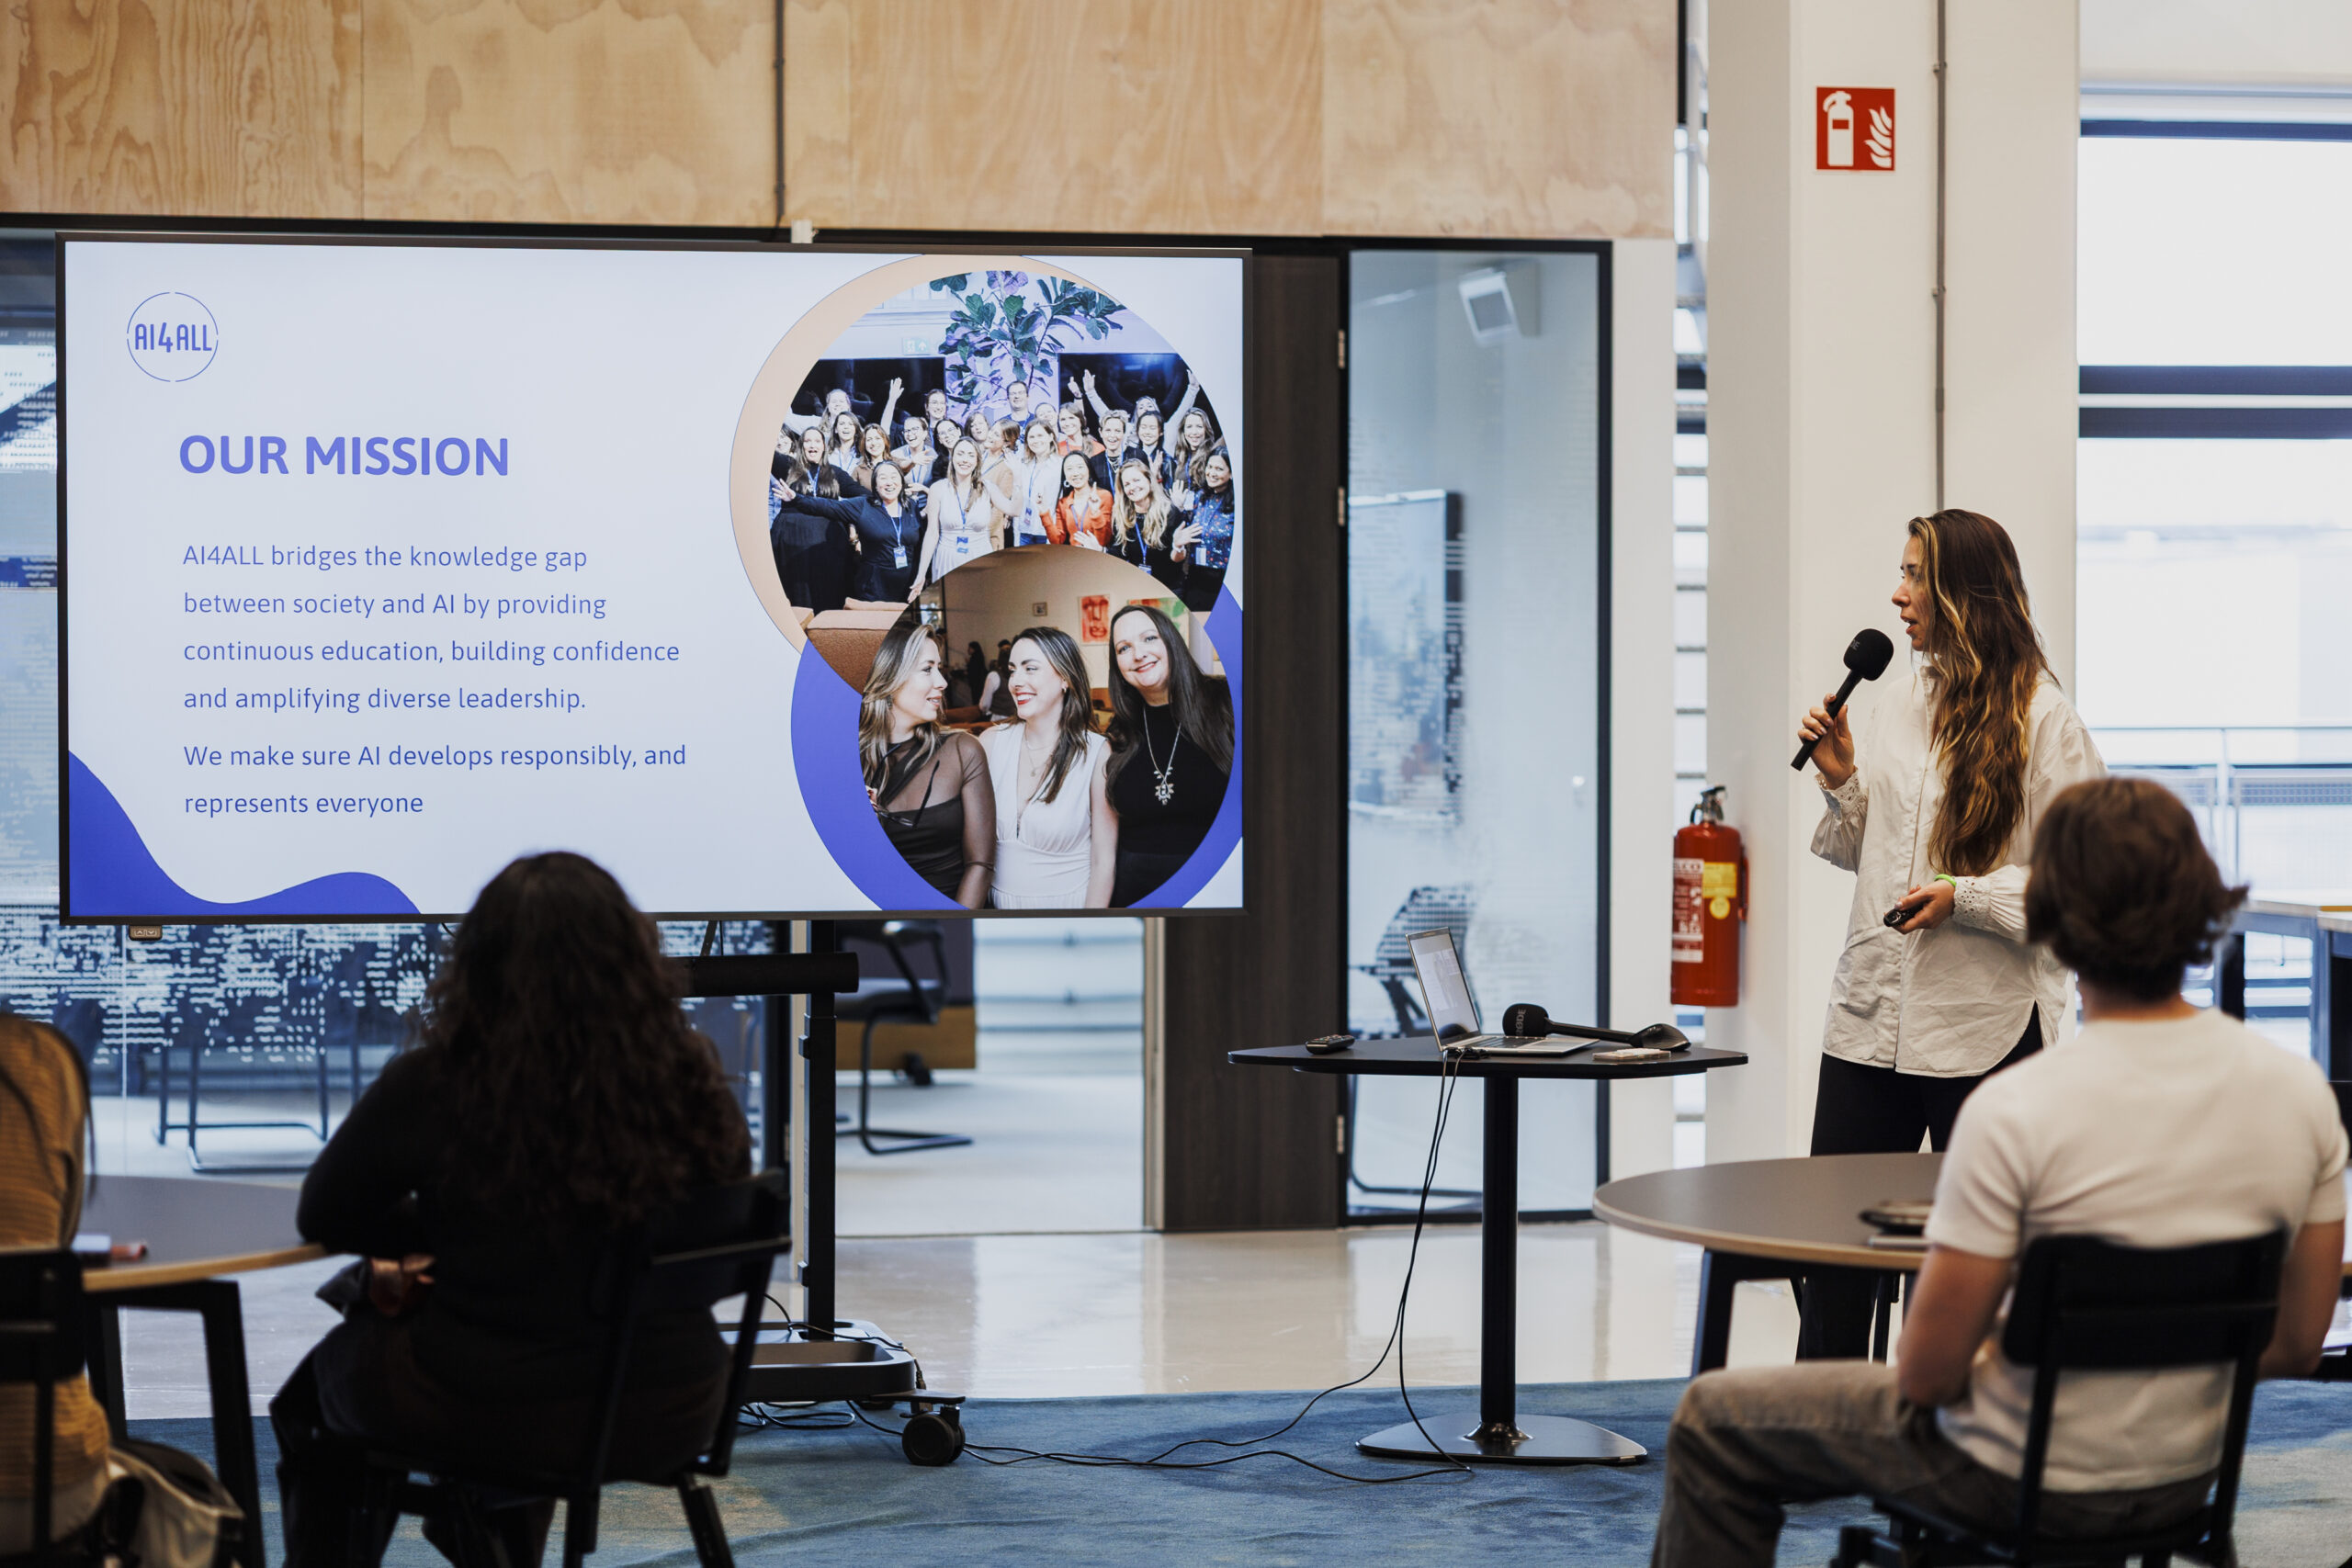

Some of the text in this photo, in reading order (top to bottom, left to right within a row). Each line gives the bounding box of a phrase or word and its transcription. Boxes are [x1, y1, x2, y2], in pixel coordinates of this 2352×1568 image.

[134, 321, 212, 353] AI4ALL
[179, 435, 508, 476] OUR MISSION
[183, 545, 588, 573] AI4ALL bridges the knowledge gap
[184, 592, 606, 620] between society and AI by providing
[183, 639, 680, 667] continuous education, building confidence
[183, 687, 586, 714] and amplifying diverse leadership.
[183, 743, 686, 772] We make sure AI develops responsibly, and
[185, 795, 424, 819] represents everyone
